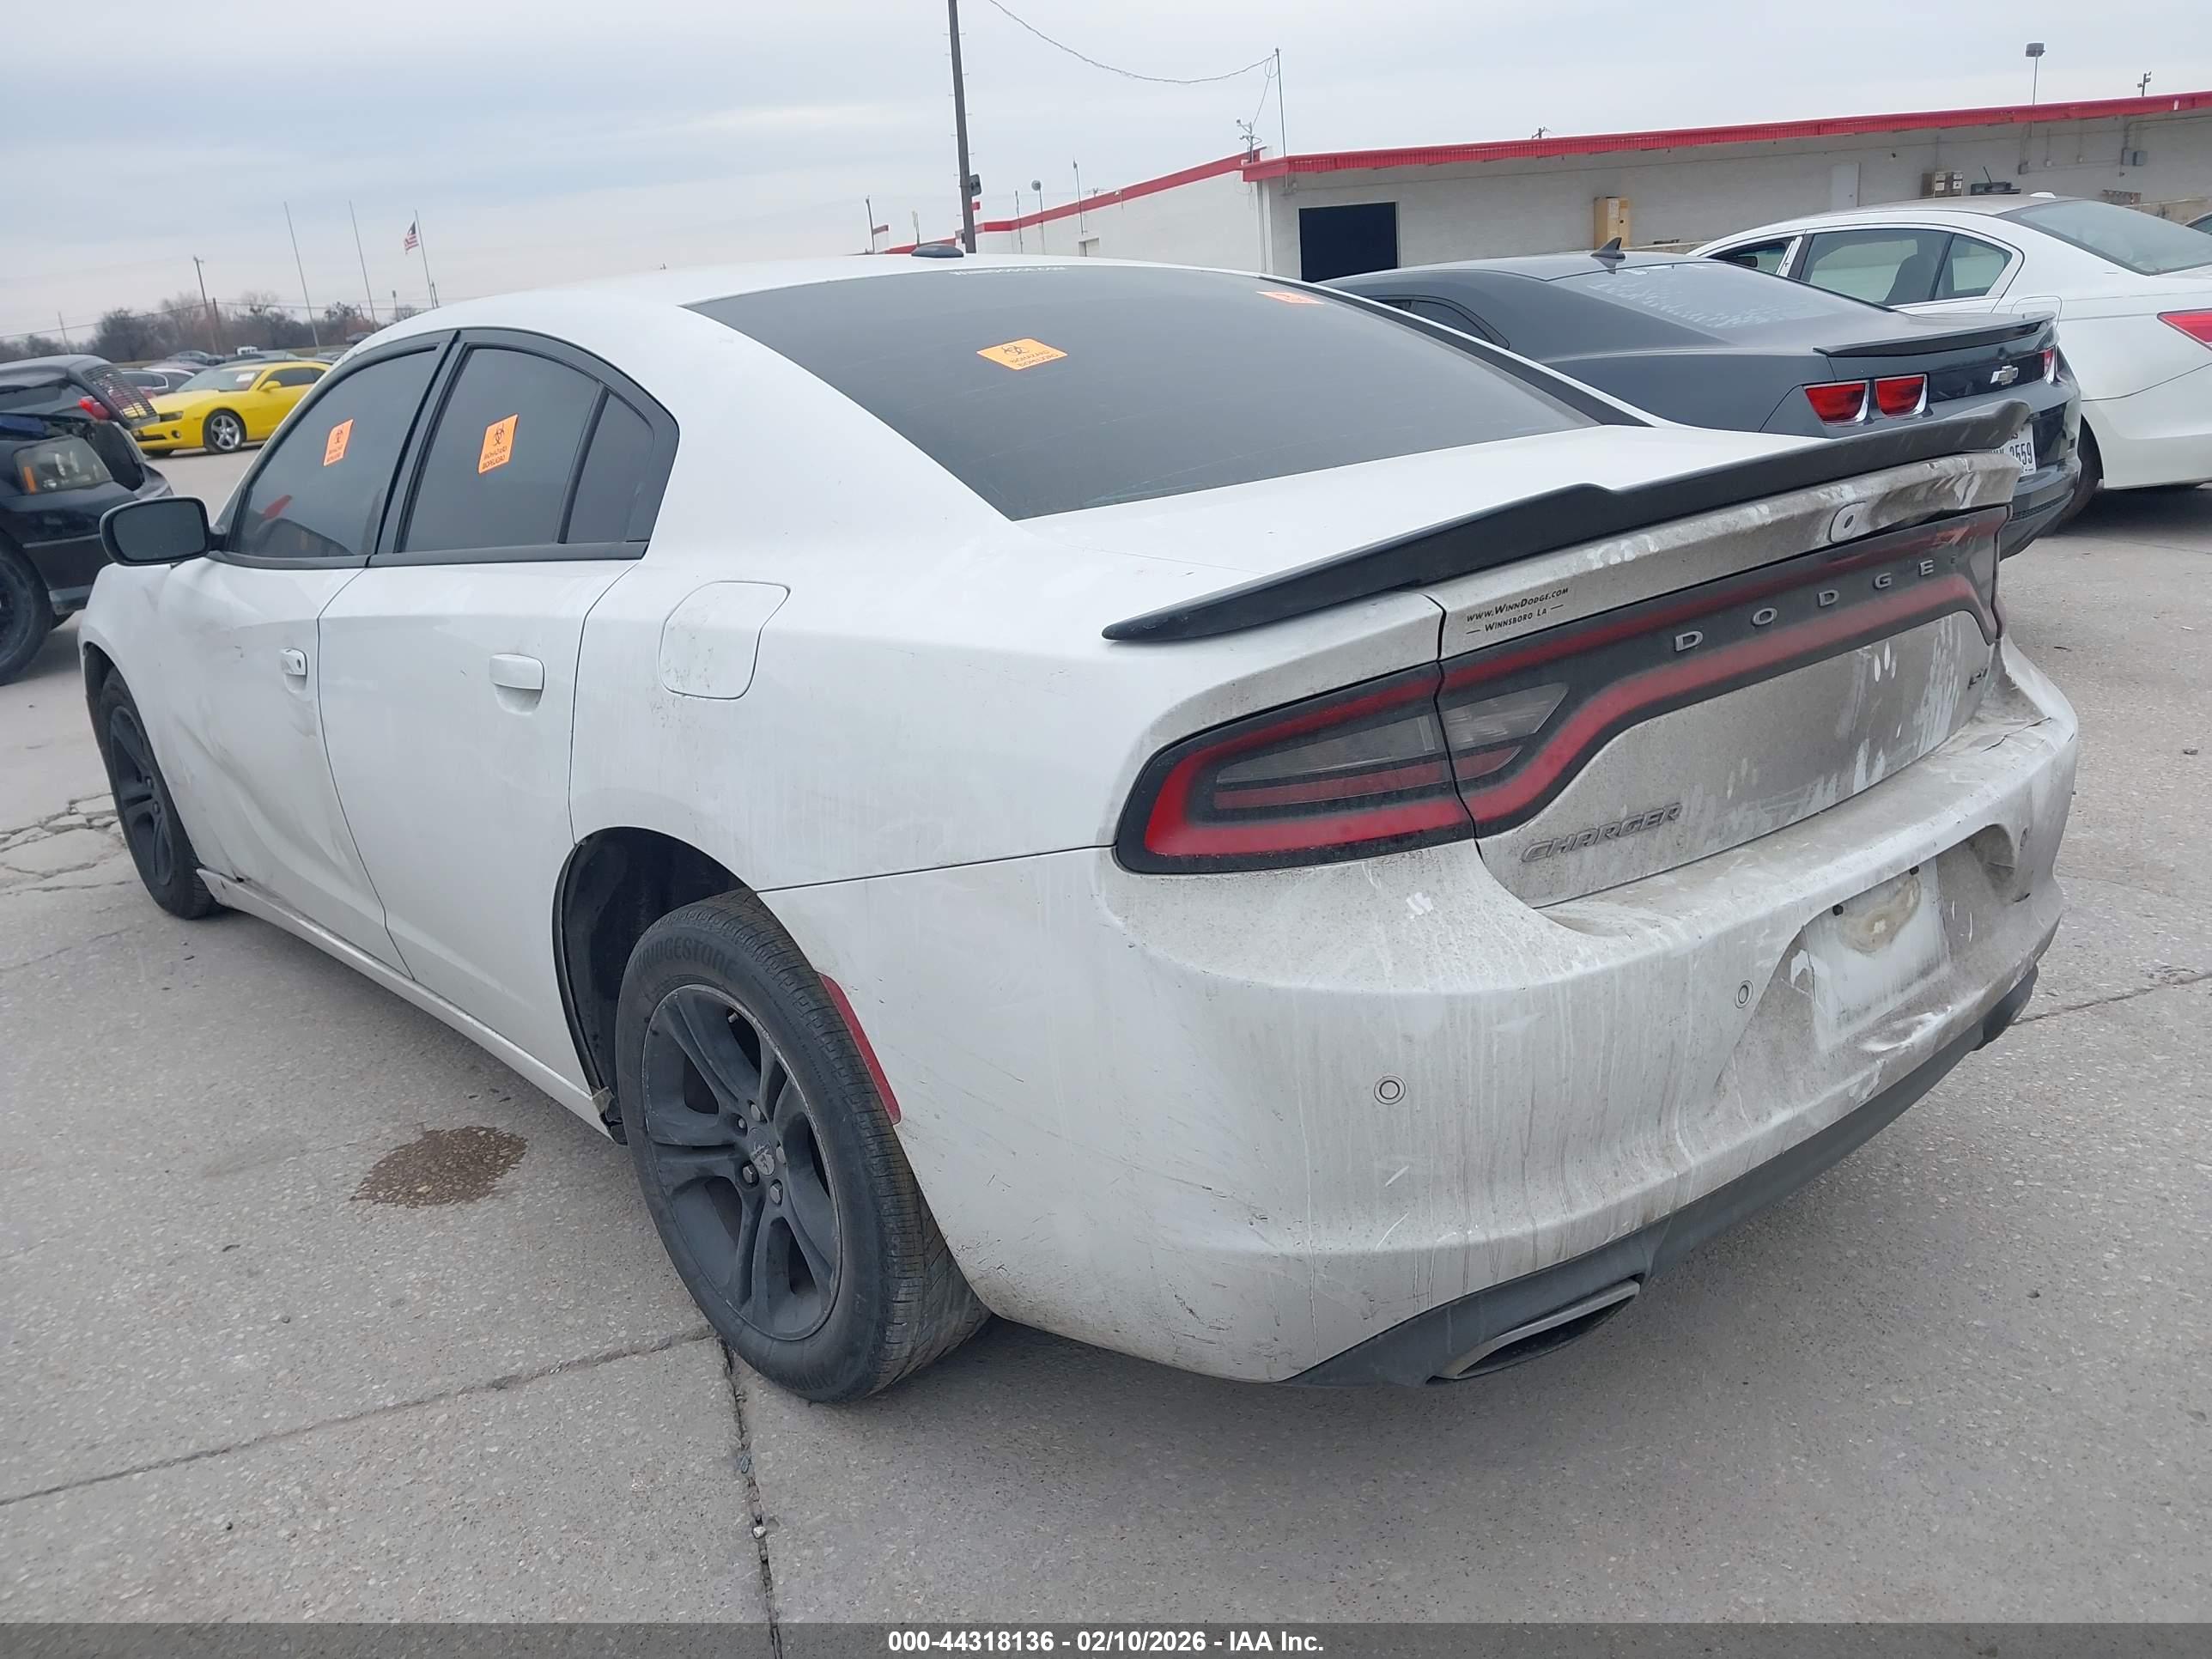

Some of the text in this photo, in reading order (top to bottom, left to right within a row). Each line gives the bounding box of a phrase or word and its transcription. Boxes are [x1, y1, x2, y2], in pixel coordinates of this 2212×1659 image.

[1484, 612, 1534, 632] WINNSBORO
[1675, 559, 1935, 653] DODGE
[1519, 802, 1683, 863] CHARGER
